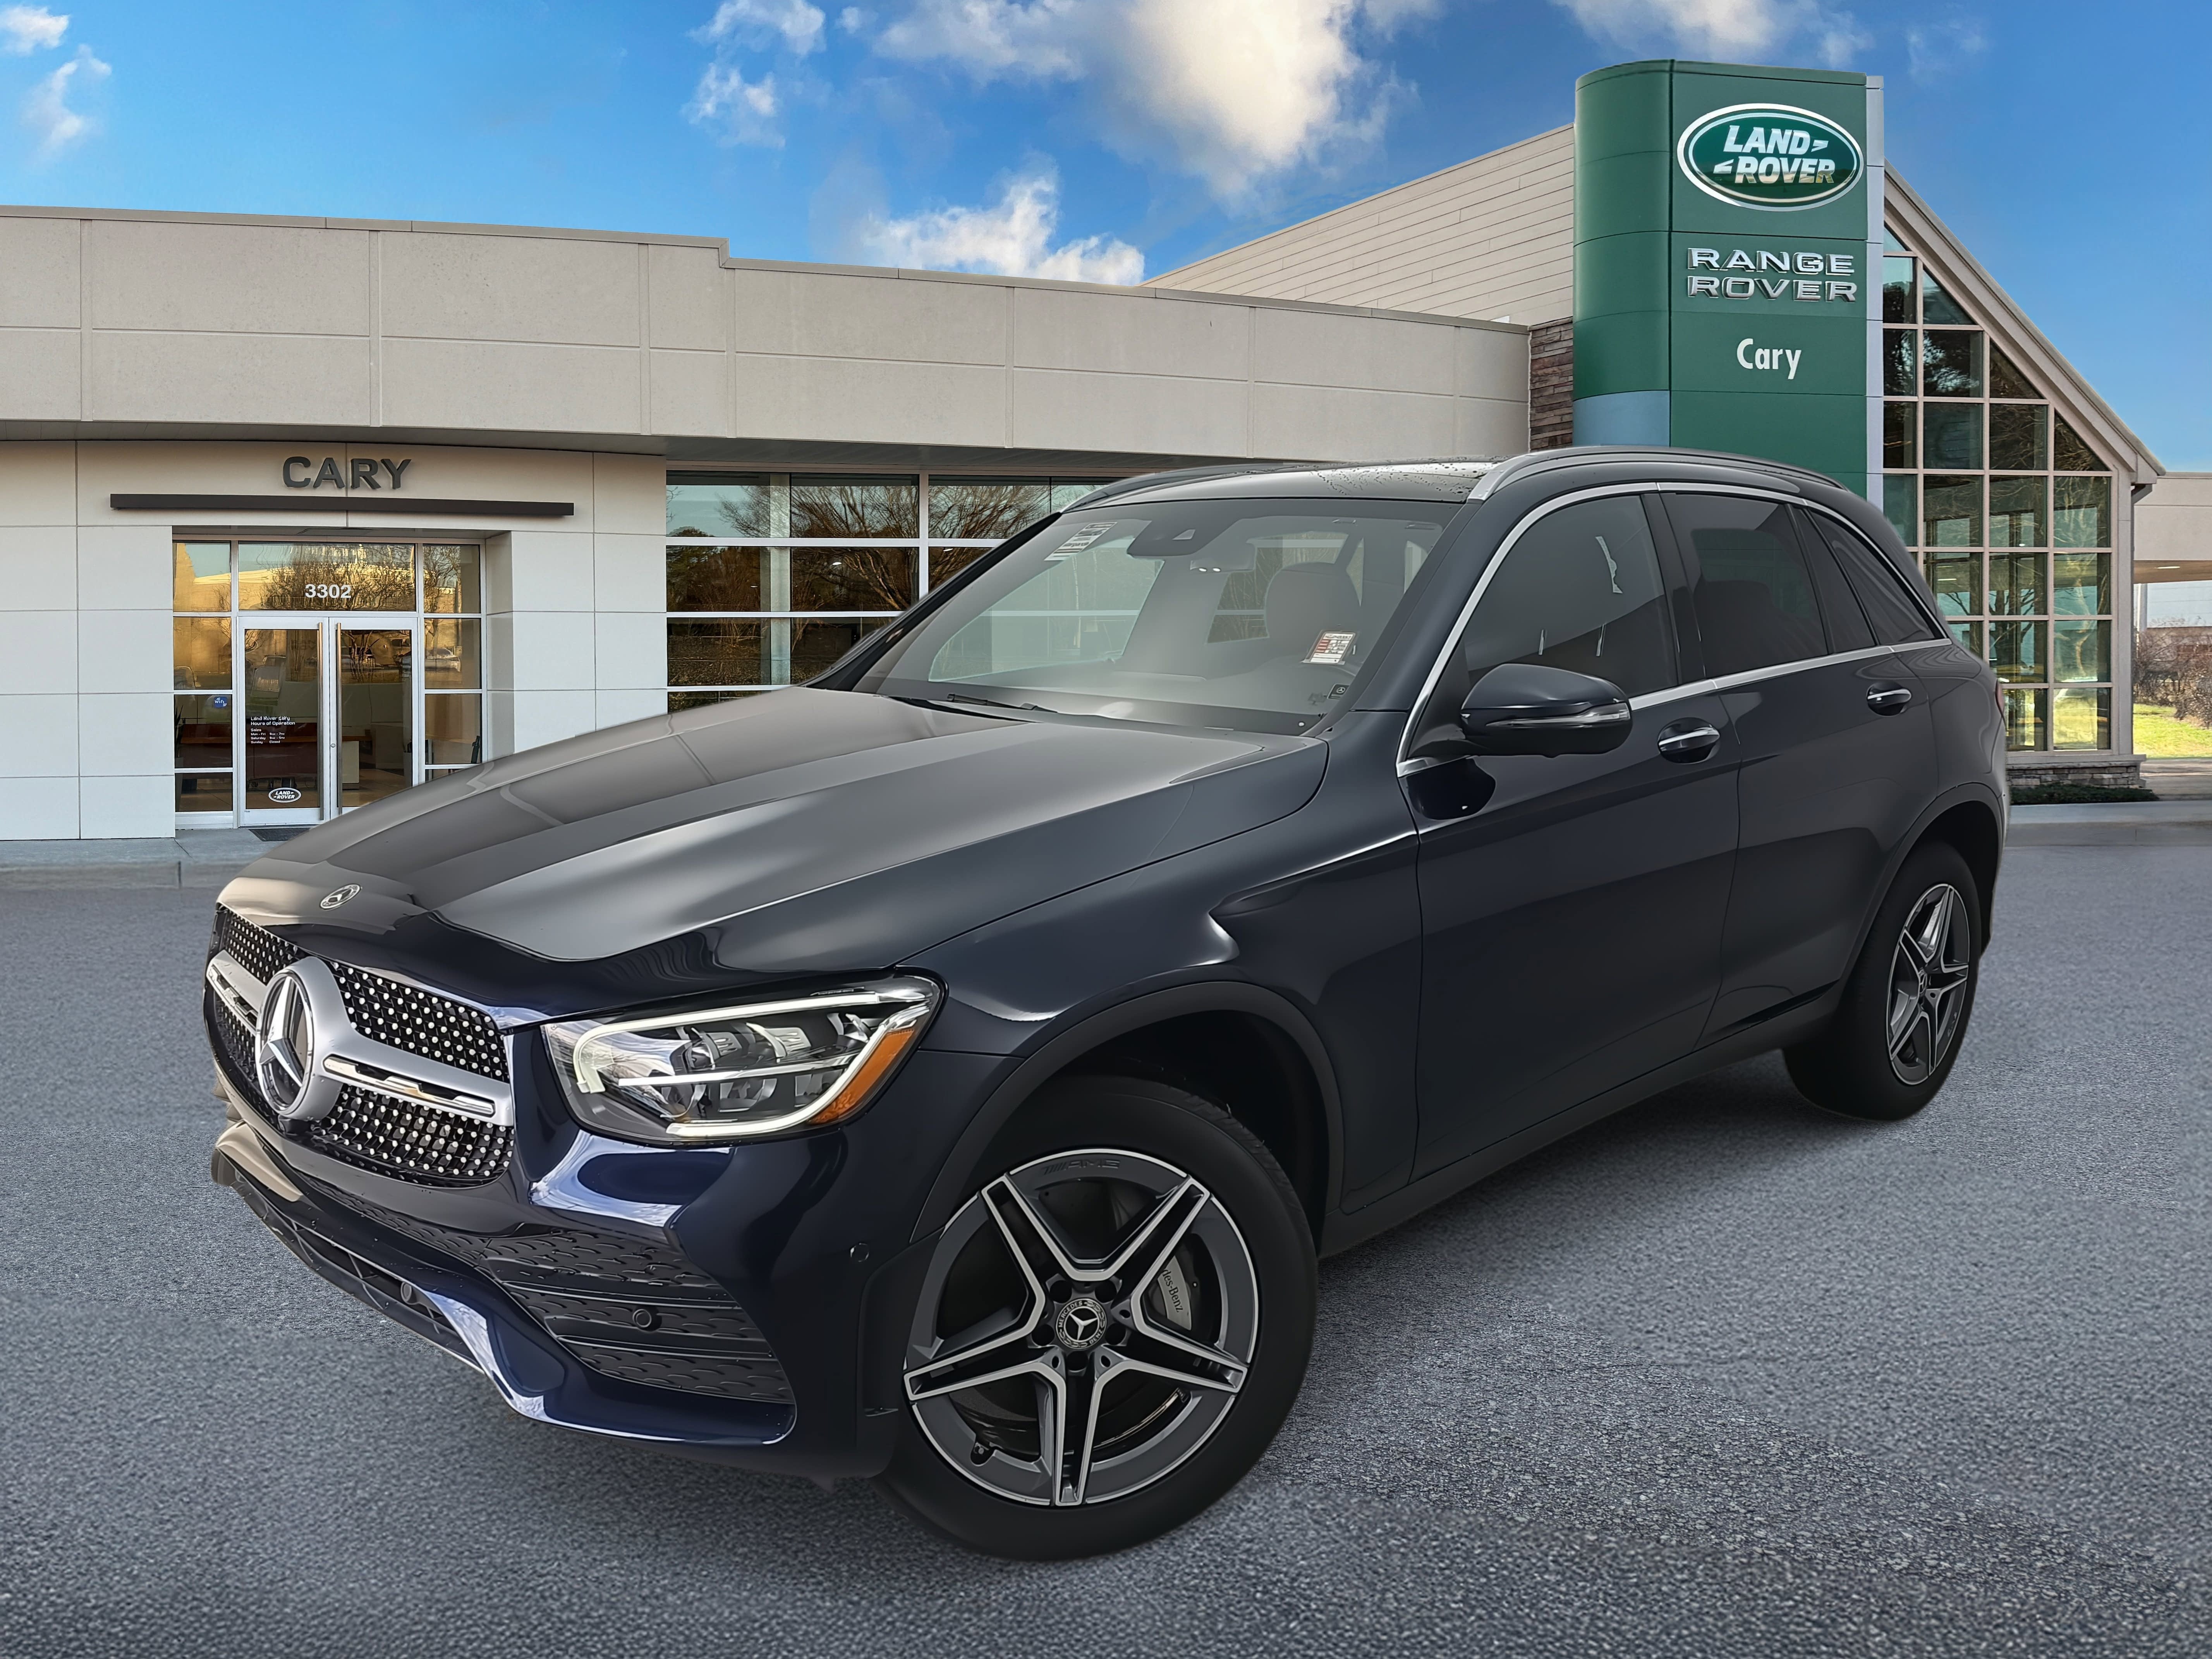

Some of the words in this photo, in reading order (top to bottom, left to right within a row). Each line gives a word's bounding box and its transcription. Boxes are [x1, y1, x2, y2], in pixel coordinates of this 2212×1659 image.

[1723, 125, 1811, 154] LAND
[1735, 156, 1836, 184] ROVER
[1687, 248, 1855, 276] RANGE
[1687, 275, 1858, 302] ROVER
[1736, 338, 1802, 380] Cary
[283, 456, 412, 489] CARY
[305, 584, 352, 599] 3302
[1163, 1269, 1183, 1313] des-Benz
[1058, 1300, 1083, 1328] MERCEDES
[1089, 1329, 1103, 1344] BENZ
